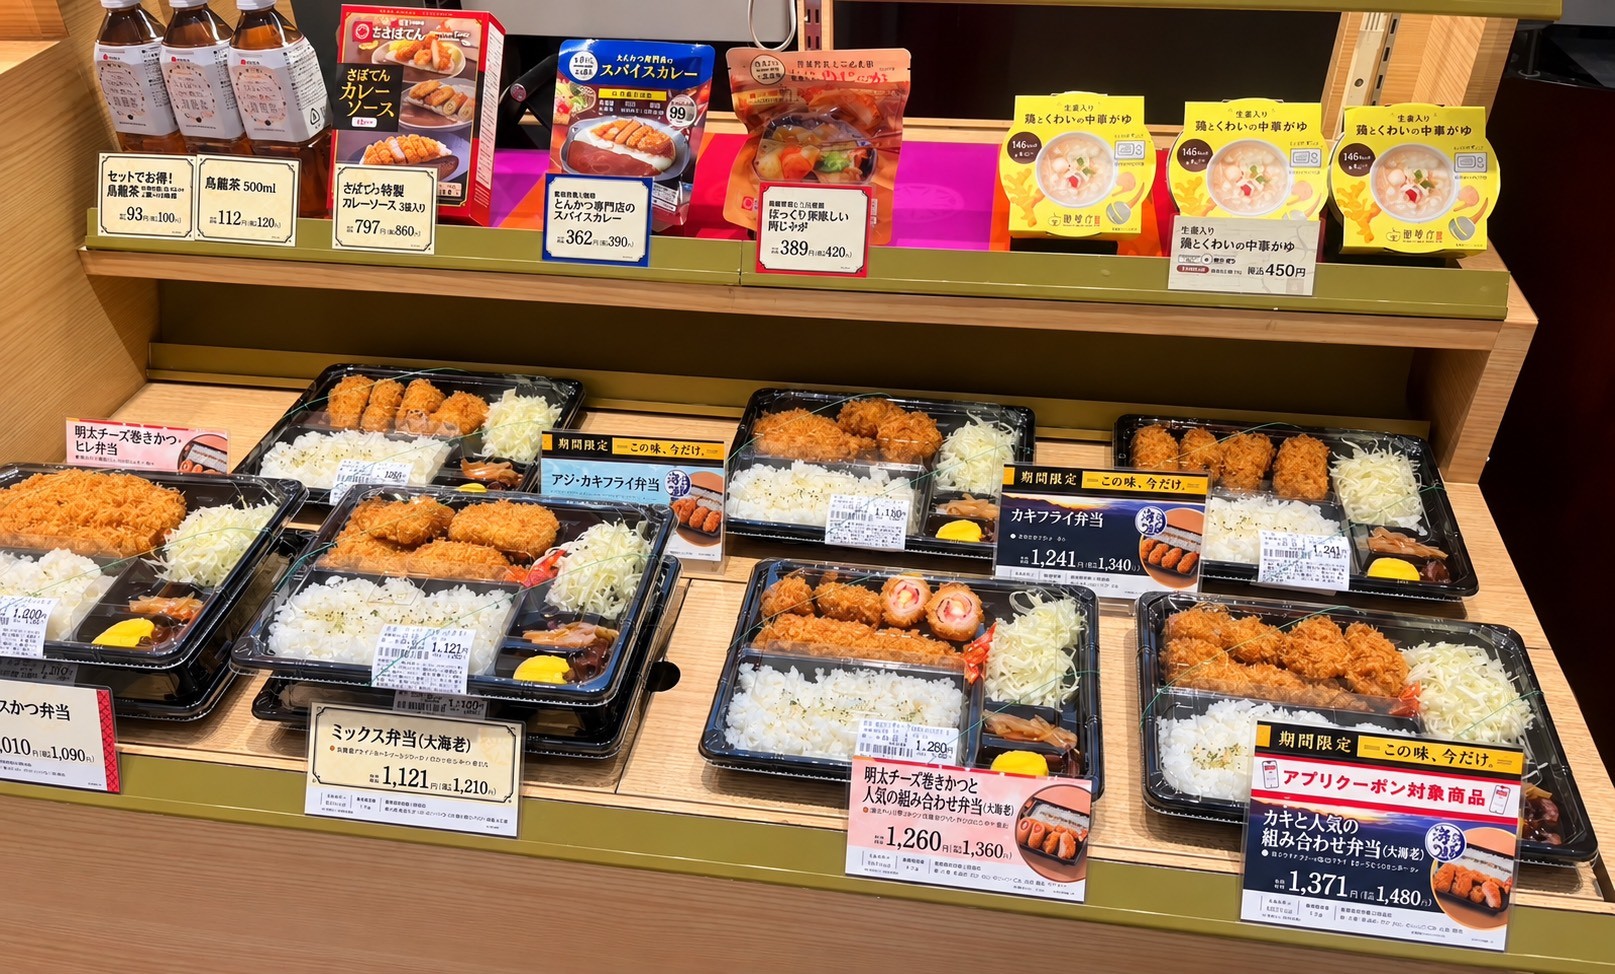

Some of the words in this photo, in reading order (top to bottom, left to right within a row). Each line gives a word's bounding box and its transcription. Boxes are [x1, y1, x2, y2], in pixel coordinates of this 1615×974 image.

[347, 68, 391, 82] さぼてん
[599, 63, 698, 80] スパイスカレー
[339, 82, 390, 101] カレー
[346, 100, 396, 117] ソース
[669, 106, 687, 119] 99
[554, 199, 636, 213] とんかつ専門店の
[75, 440, 118, 456] ヒレ弁当
[558, 437, 609, 452] 期間限定
[551, 473, 660, 492] アジ・カキフライ弁当
[1020, 471, 1077, 485] 期間限定
[1011, 508, 1104, 528] カキフライ弁当
[332, 723, 471, 753] ミックス弁当(大海老)
[1278, 730, 1352, 753] 期間限定
[864, 766, 978, 794] 明太チーズ巻きかつと
[1283, 769, 1486, 807] アプリクーポン対象商品
[1263, 810, 1359, 835] カキと人気の
